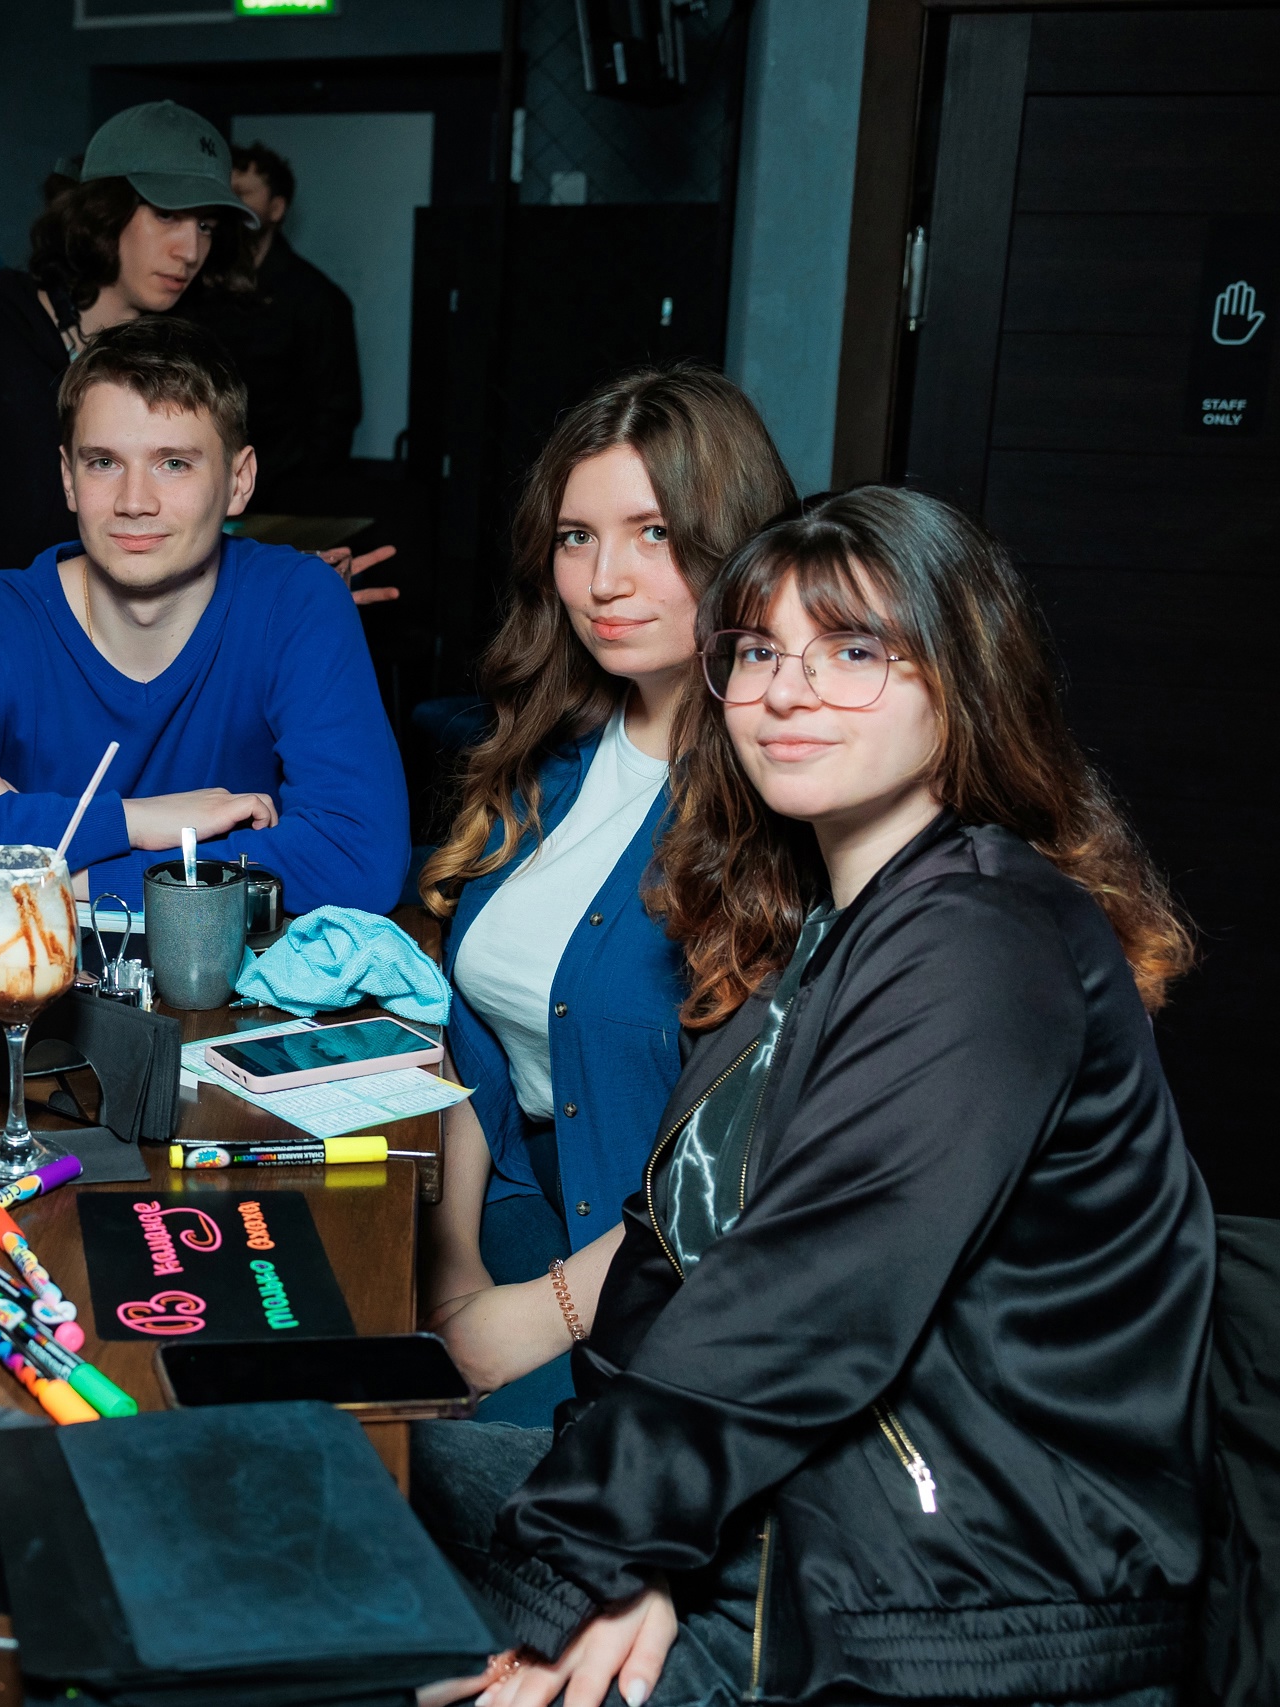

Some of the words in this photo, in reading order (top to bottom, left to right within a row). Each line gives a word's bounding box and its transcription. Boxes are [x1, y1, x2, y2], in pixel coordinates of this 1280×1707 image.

[1201, 398, 1248, 411] STAFF
[1202, 413, 1244, 426] ONLY
[277, 1152, 303, 1161] MARKER
[304, 1151, 325, 1160] CHALK
